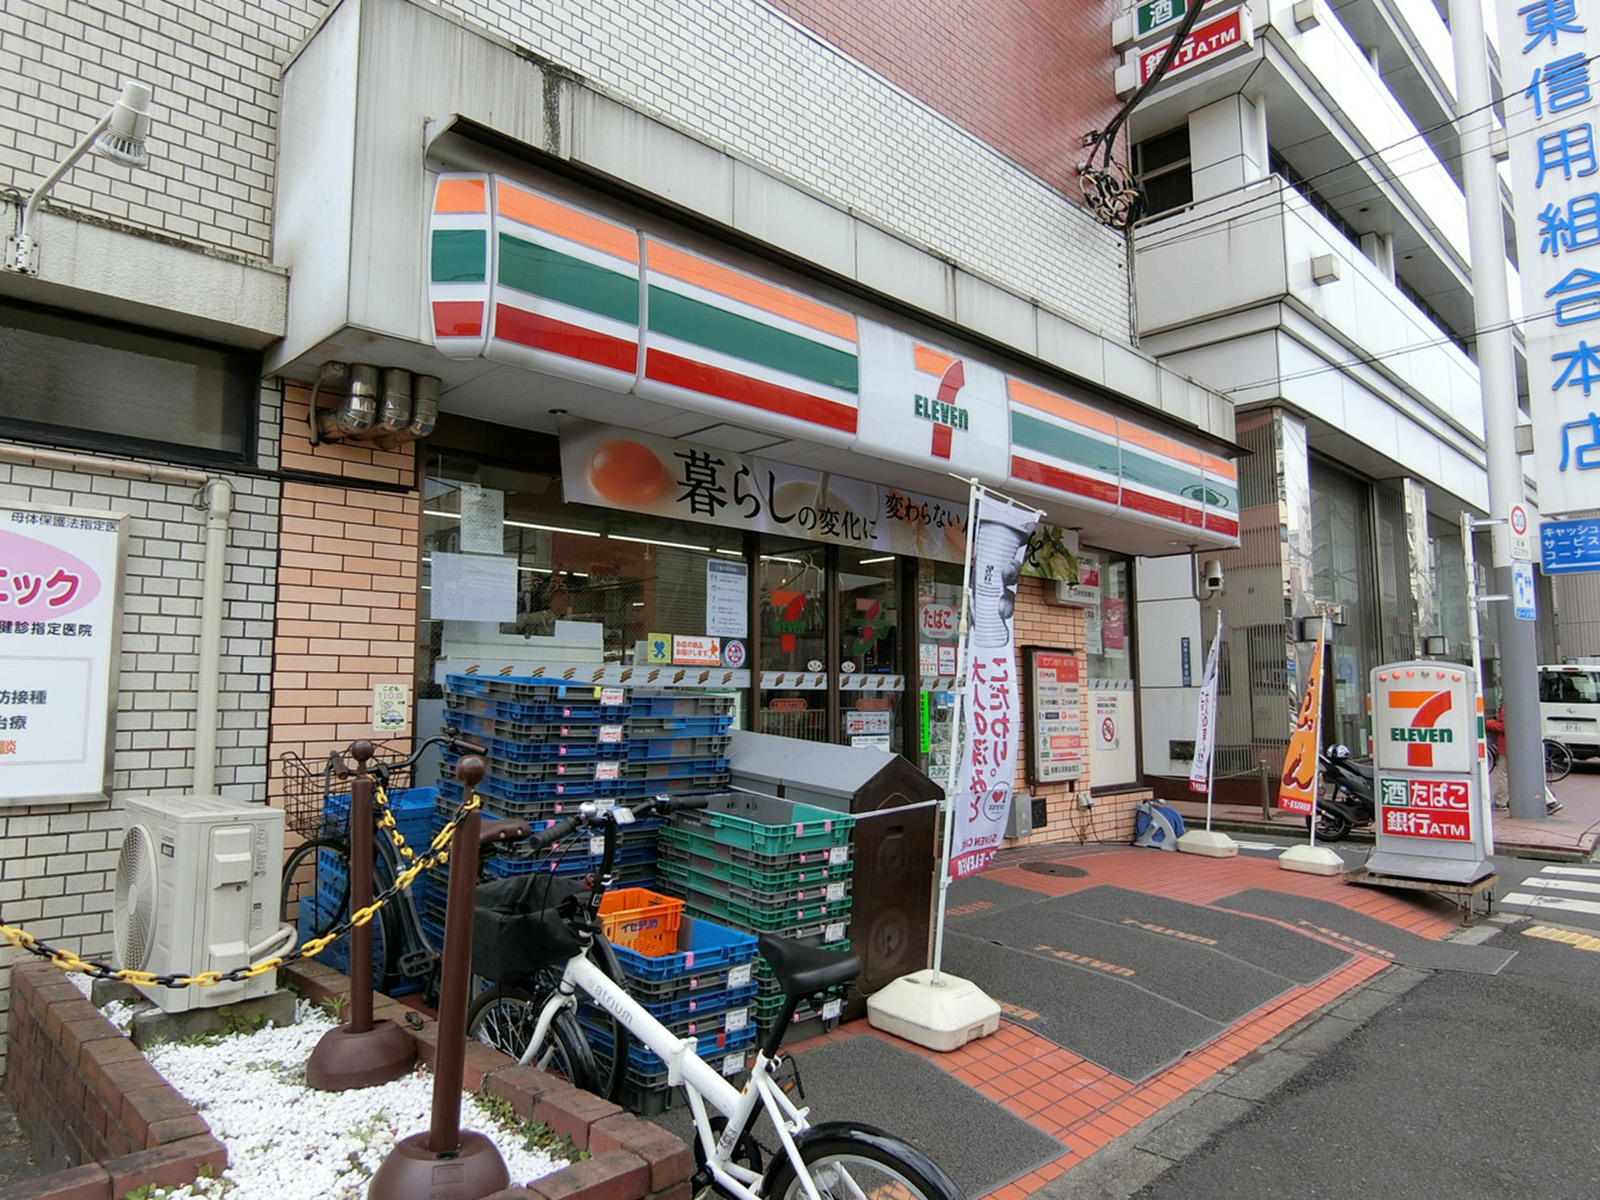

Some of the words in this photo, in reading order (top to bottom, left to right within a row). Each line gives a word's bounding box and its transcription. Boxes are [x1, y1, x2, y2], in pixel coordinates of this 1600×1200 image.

[1544, 525, 1599, 537] キャッシュ
[1544, 536, 1599, 549] サービス
[1545, 549, 1600, 560] コーナー
[923, 608, 953, 629] たばこ
[1383, 780, 1407, 805] 酒
[1411, 782, 1467, 808] たばこ
[1386, 811, 1465, 836] 銀行ATM
[594, 983, 633, 1025] atrium
